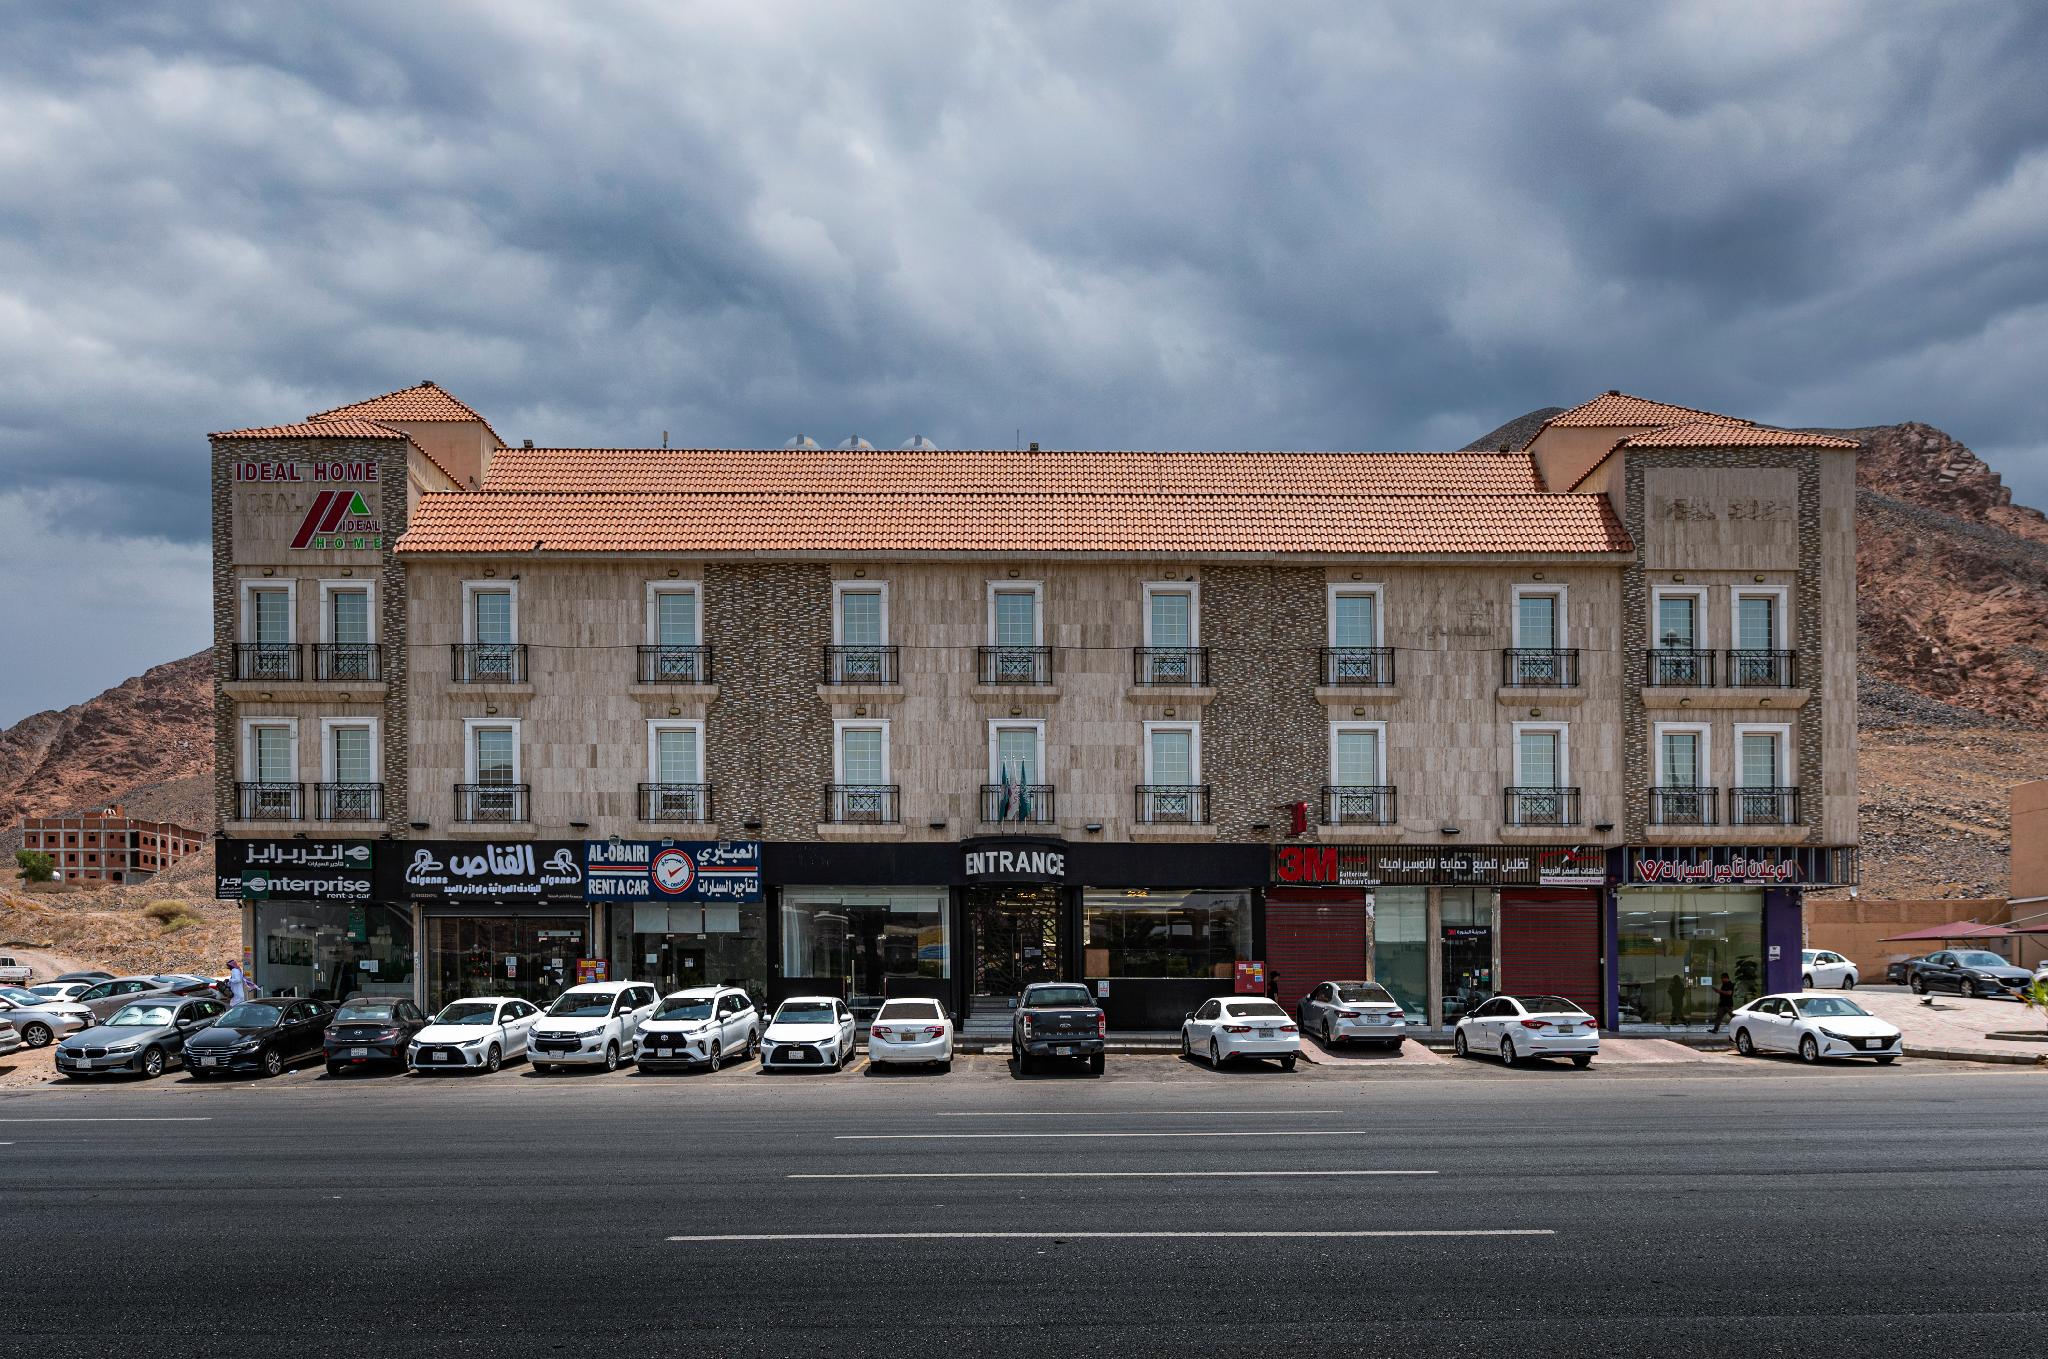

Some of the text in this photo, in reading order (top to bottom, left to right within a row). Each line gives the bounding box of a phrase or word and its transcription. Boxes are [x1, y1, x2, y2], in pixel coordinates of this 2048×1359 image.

[235, 462, 379, 482] IDEAL HOME
[342, 520, 382, 532] IDEAL
[315, 537, 383, 549] HOME
[246, 843, 343, 864] انتربرايز
[449, 844, 536, 878] القناص
[588, 844, 649, 862] AL-OBAIRI
[696, 843, 758, 865] العبيري
[966, 851, 1064, 876] ENTRANCE
[1278, 847, 1338, 881] 3M
[1440, 857, 1467, 872] حماية
[1472, 858, 1498, 873] تلميع
[1501, 858, 1529, 872] تظليل
[1662, 853, 1793, 883] الوعلان لتأجير السيارات
[243, 876, 371, 895] enterprise
[588, 879, 649, 895] RENT A CAR
[697, 877, 759, 898] لتأجير السيارات
